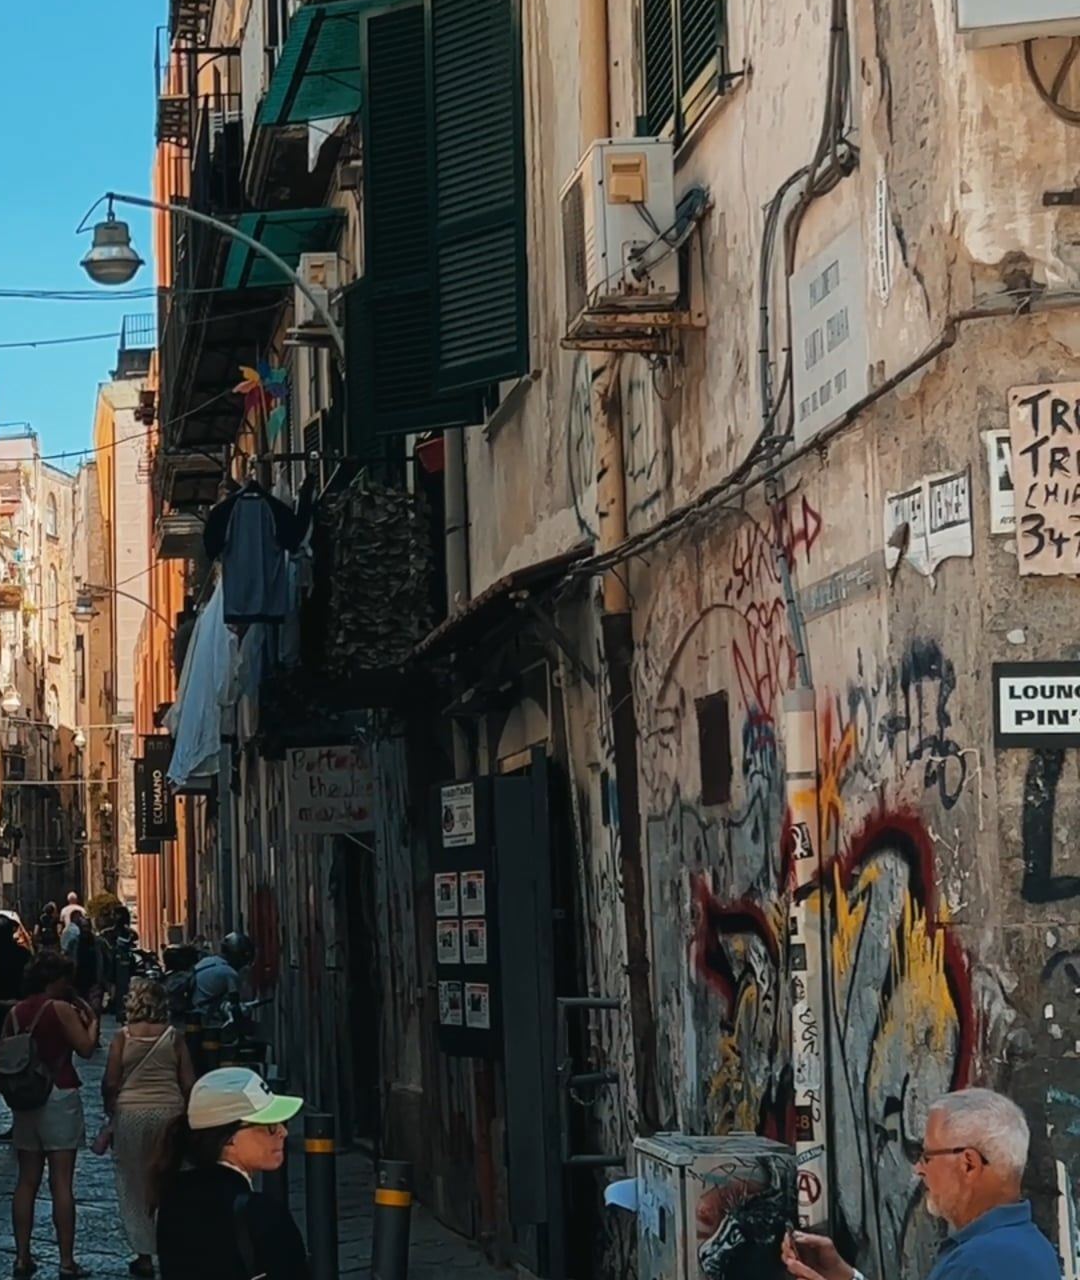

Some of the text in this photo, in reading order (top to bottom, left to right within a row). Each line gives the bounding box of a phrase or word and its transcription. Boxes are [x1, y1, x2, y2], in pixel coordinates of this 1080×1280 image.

[1019, 435, 1080, 478] TR
[1015, 709, 1080, 726] PIN'
[152, 769, 164, 825] ECUMANO
